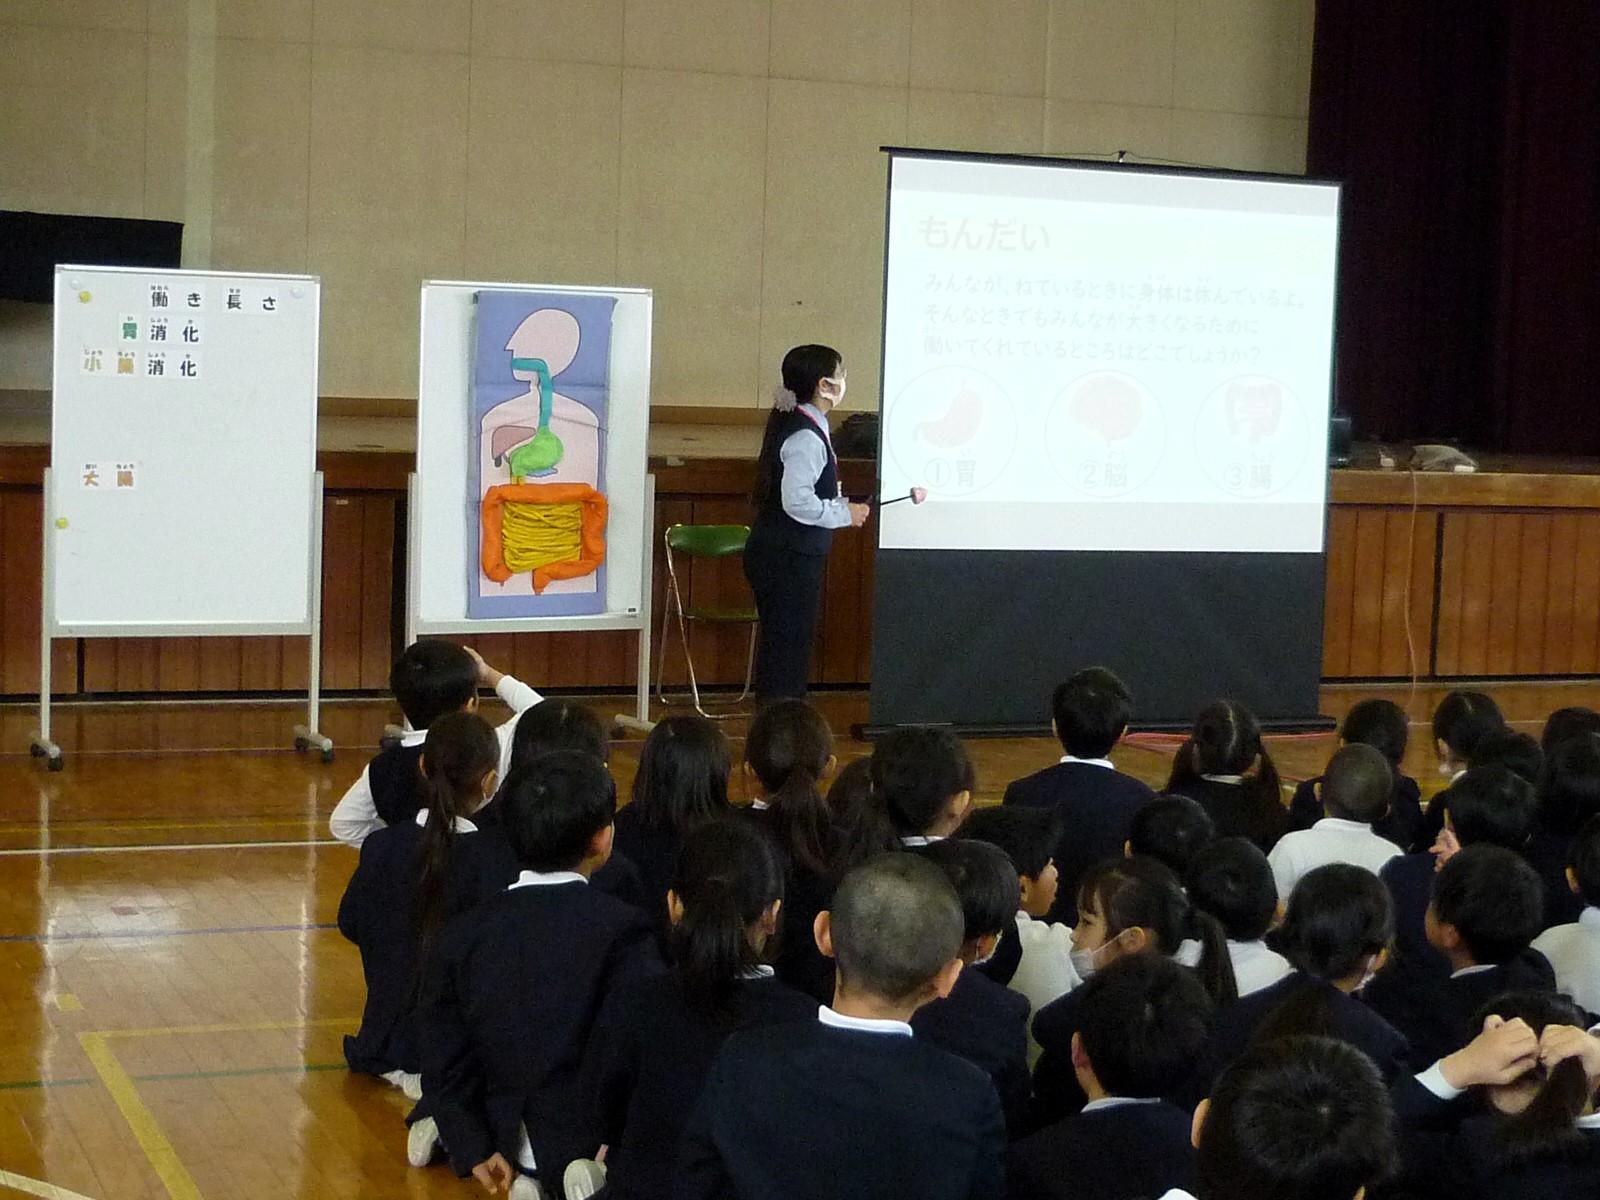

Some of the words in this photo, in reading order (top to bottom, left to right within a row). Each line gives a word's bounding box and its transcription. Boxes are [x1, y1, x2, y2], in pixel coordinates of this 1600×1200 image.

[919, 215, 1051, 252] もんだい
[152, 292, 201, 308] 働き
[227, 294, 276, 311] 長さ
[150, 324, 199, 342] 消化
[148, 359, 197, 377] 消化
